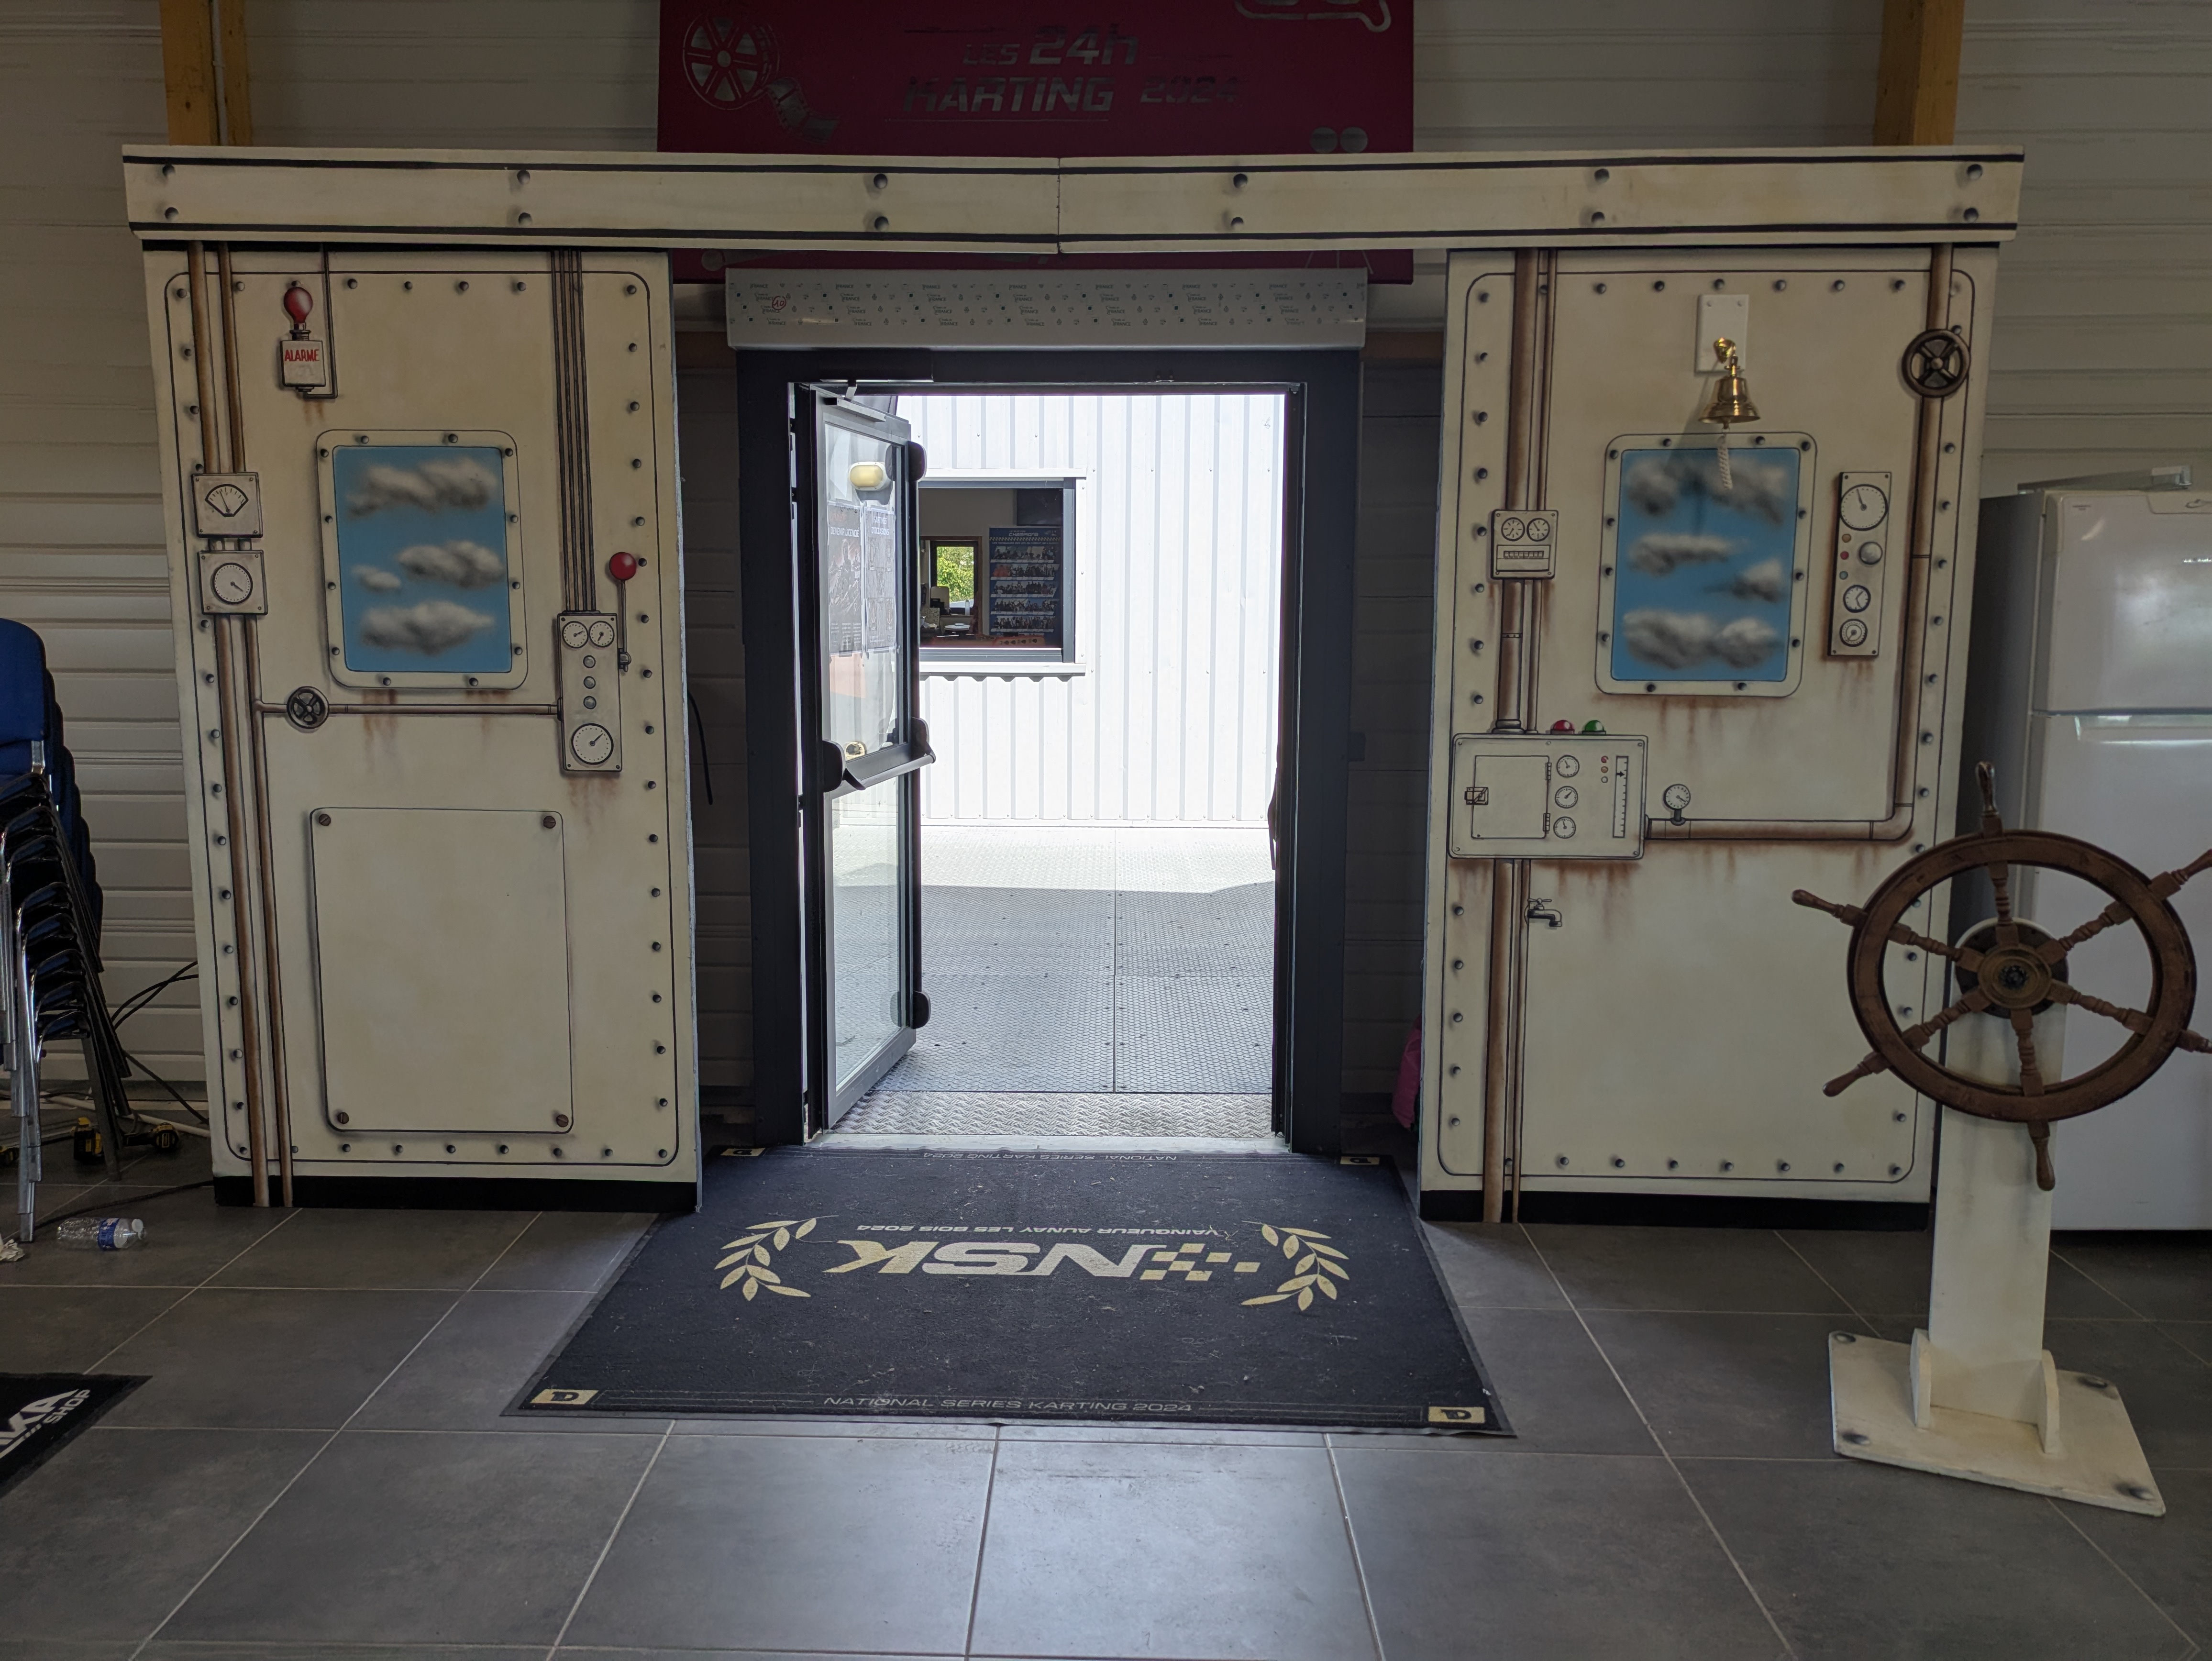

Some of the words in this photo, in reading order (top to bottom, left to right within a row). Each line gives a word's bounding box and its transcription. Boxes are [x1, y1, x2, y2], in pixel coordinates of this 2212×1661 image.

[962, 43, 1020, 66] LES
[1029, 22, 1139, 66] 24h
[902, 77, 1115, 112] KARTING
[1140, 76, 1239, 104] 2024
[284, 349, 320, 362] ALARME
[830, 527, 845, 536] DEVENIR
[1097, 1228, 1219, 1236] VAINQUEUR
[822, 1240, 1167, 1277] NSK
[43, 1389, 91, 1424] SHOP
[823, 1396, 934, 1407] NATIONAL
[940, 1398, 1022, 1409] SERIES
[1029, 1401, 1128, 1411] KARTING
[1132, 1402, 1193, 1412] 2024
